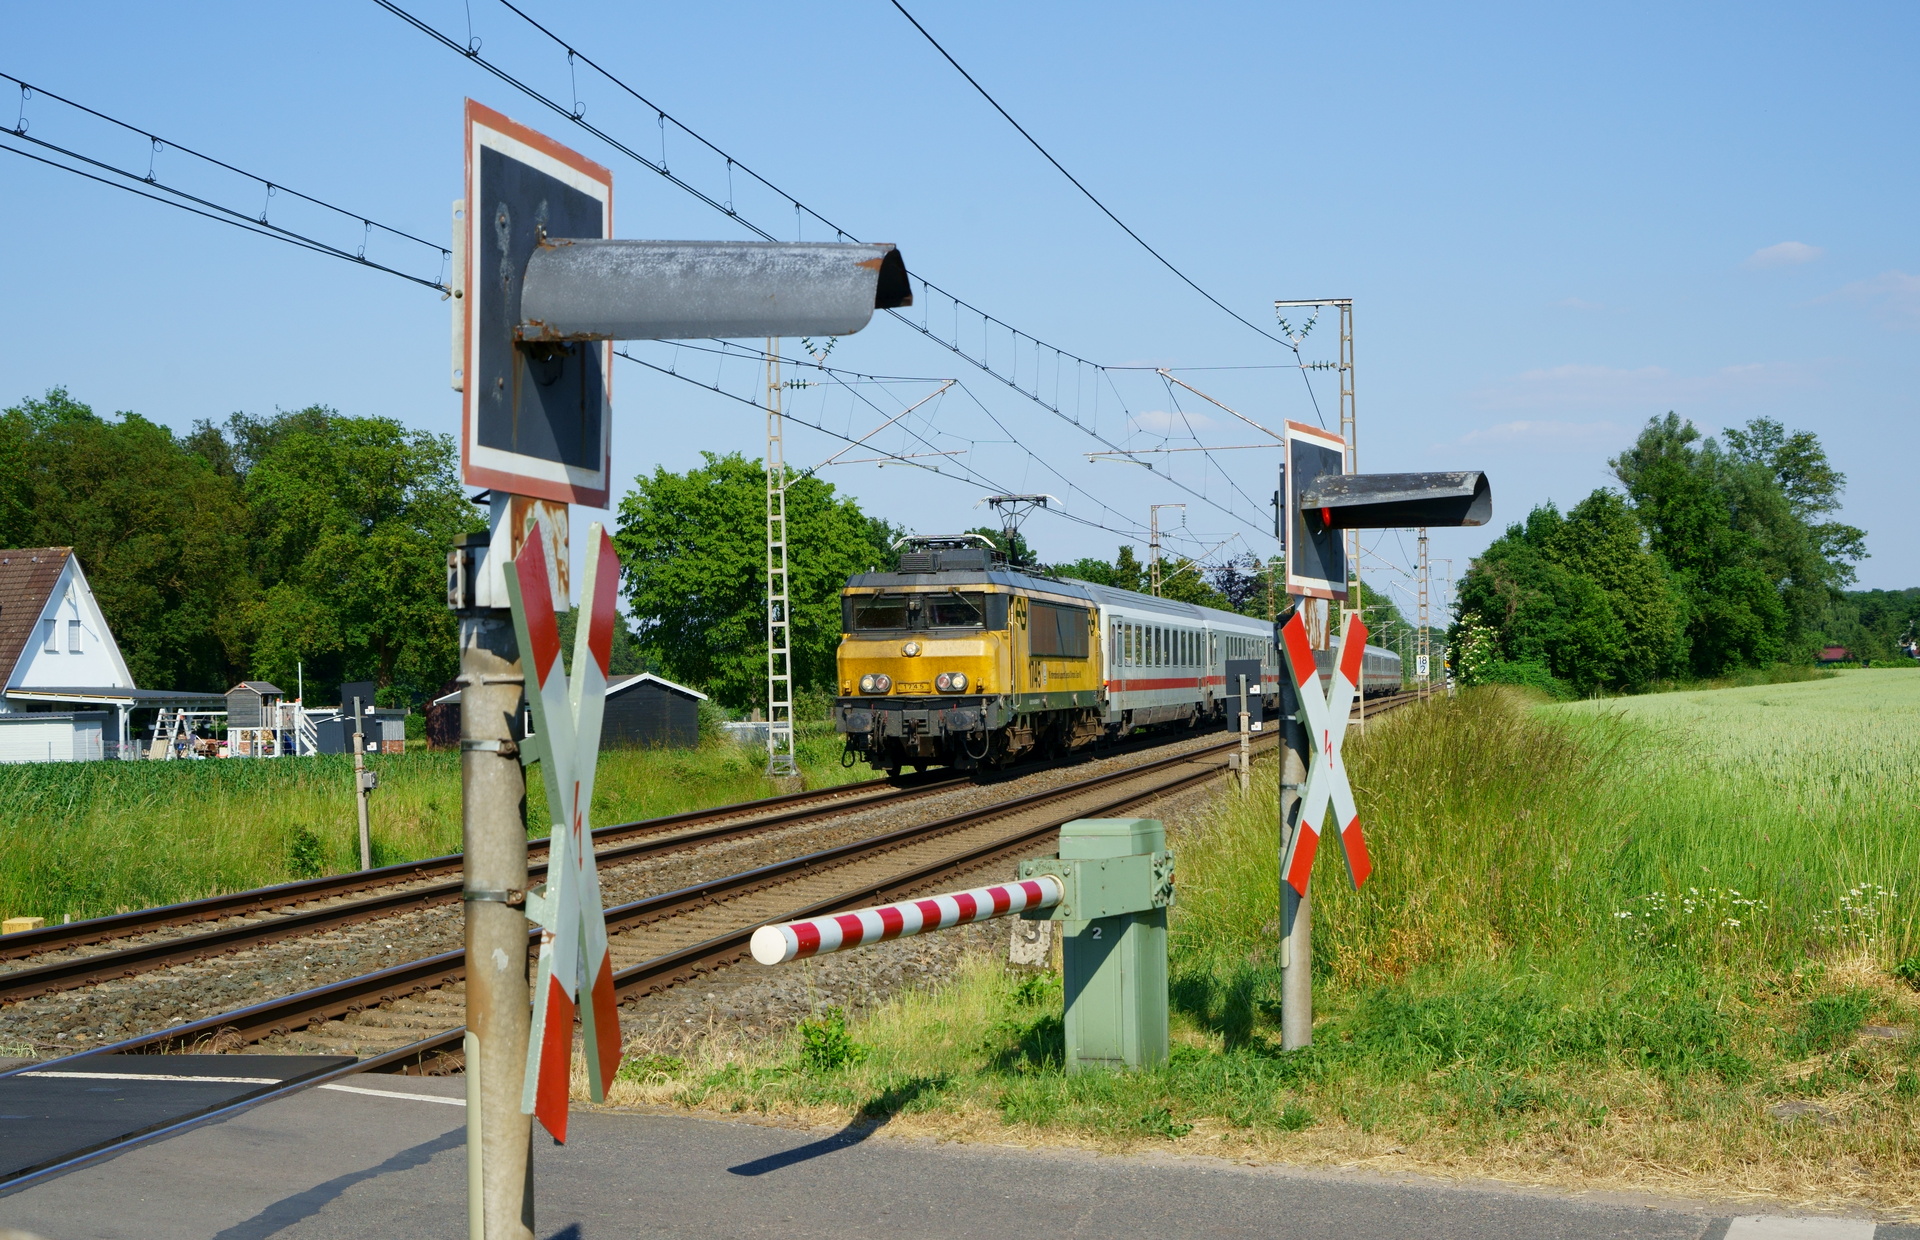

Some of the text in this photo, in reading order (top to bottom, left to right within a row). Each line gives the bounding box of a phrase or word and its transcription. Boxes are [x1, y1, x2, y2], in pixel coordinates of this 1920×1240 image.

[1419, 656, 1427, 665] 18
[1420, 665, 1426, 673] 2
[1029, 661, 1041, 688] 1745
[1092, 927, 1102, 939] 2
